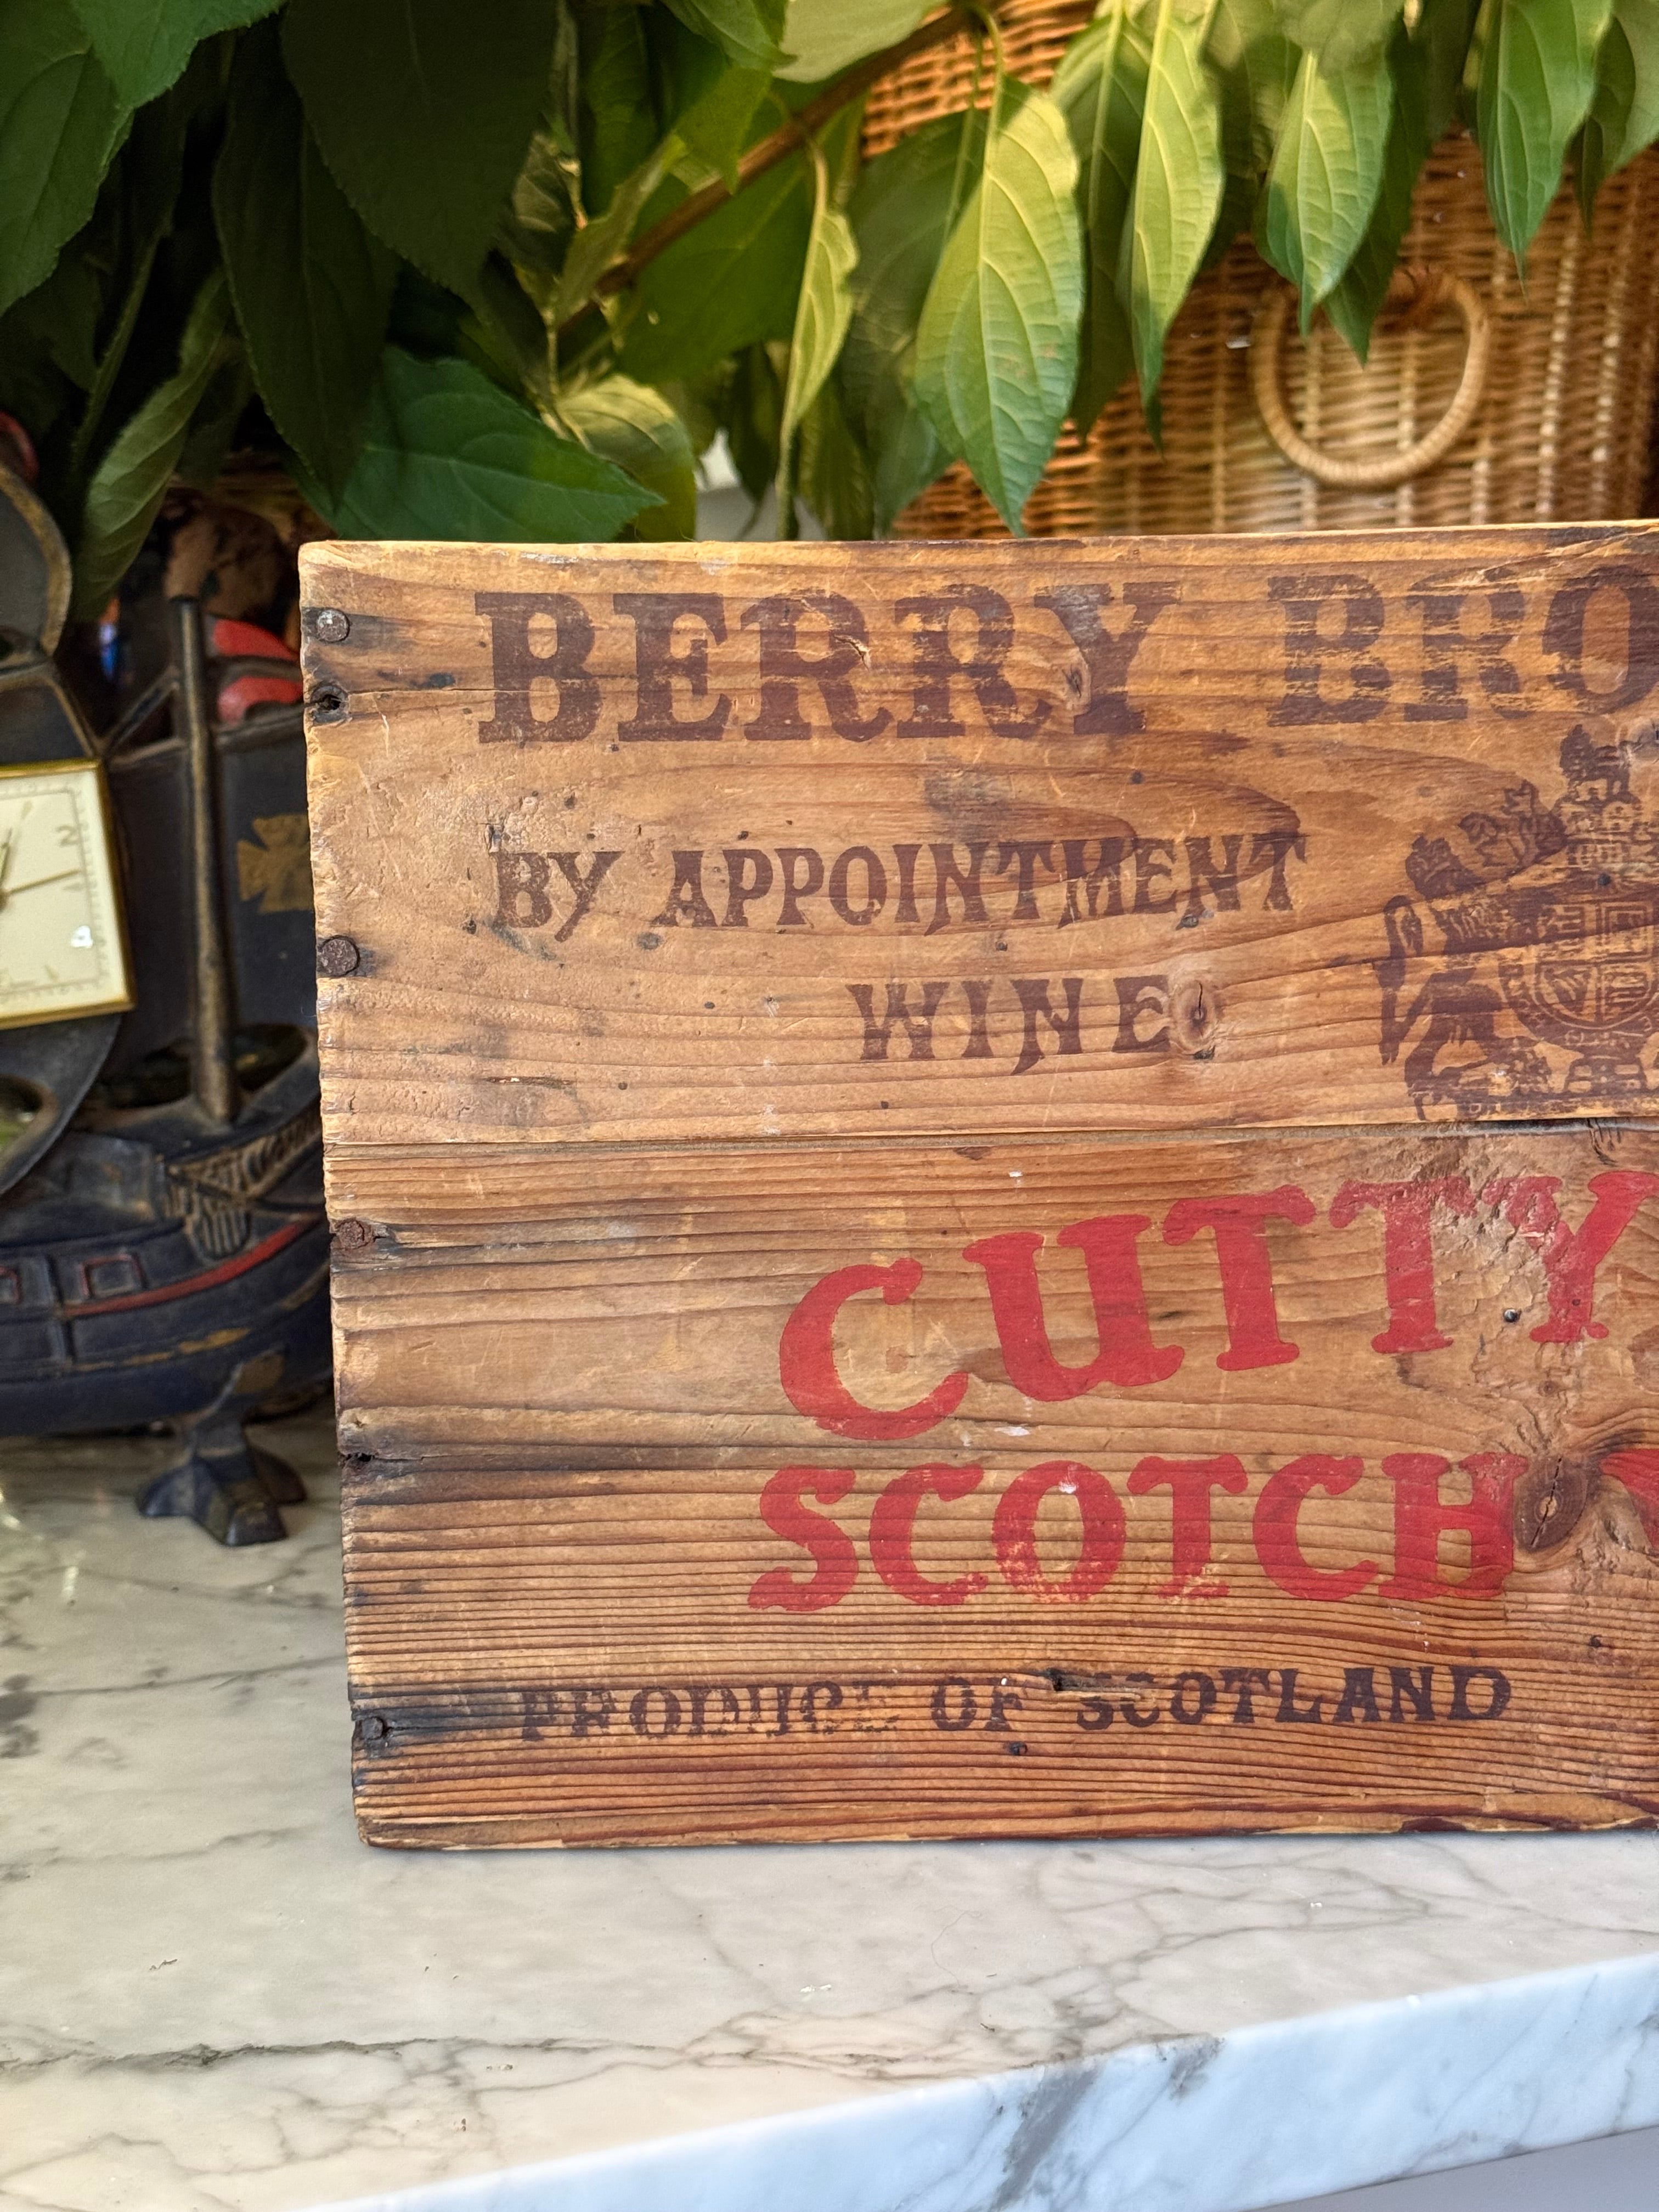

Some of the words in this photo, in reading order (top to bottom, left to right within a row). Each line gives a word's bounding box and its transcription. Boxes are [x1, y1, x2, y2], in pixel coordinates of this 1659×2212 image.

[475, 583, 1182, 742] BERRY
[1267, 564, 1659, 727] BRO
[491, 851, 625, 942] BY
[648, 833, 1310, 935] APPOINTMENT
[845, 975, 1171, 1075] WINE
[779, 1171, 1659, 1441] CUTTY
[747, 1452, 1530, 1611] SCOTCH
[930, 1677, 1027, 1731] OF
[1075, 1665, 1512, 1730] SCOTLAND
